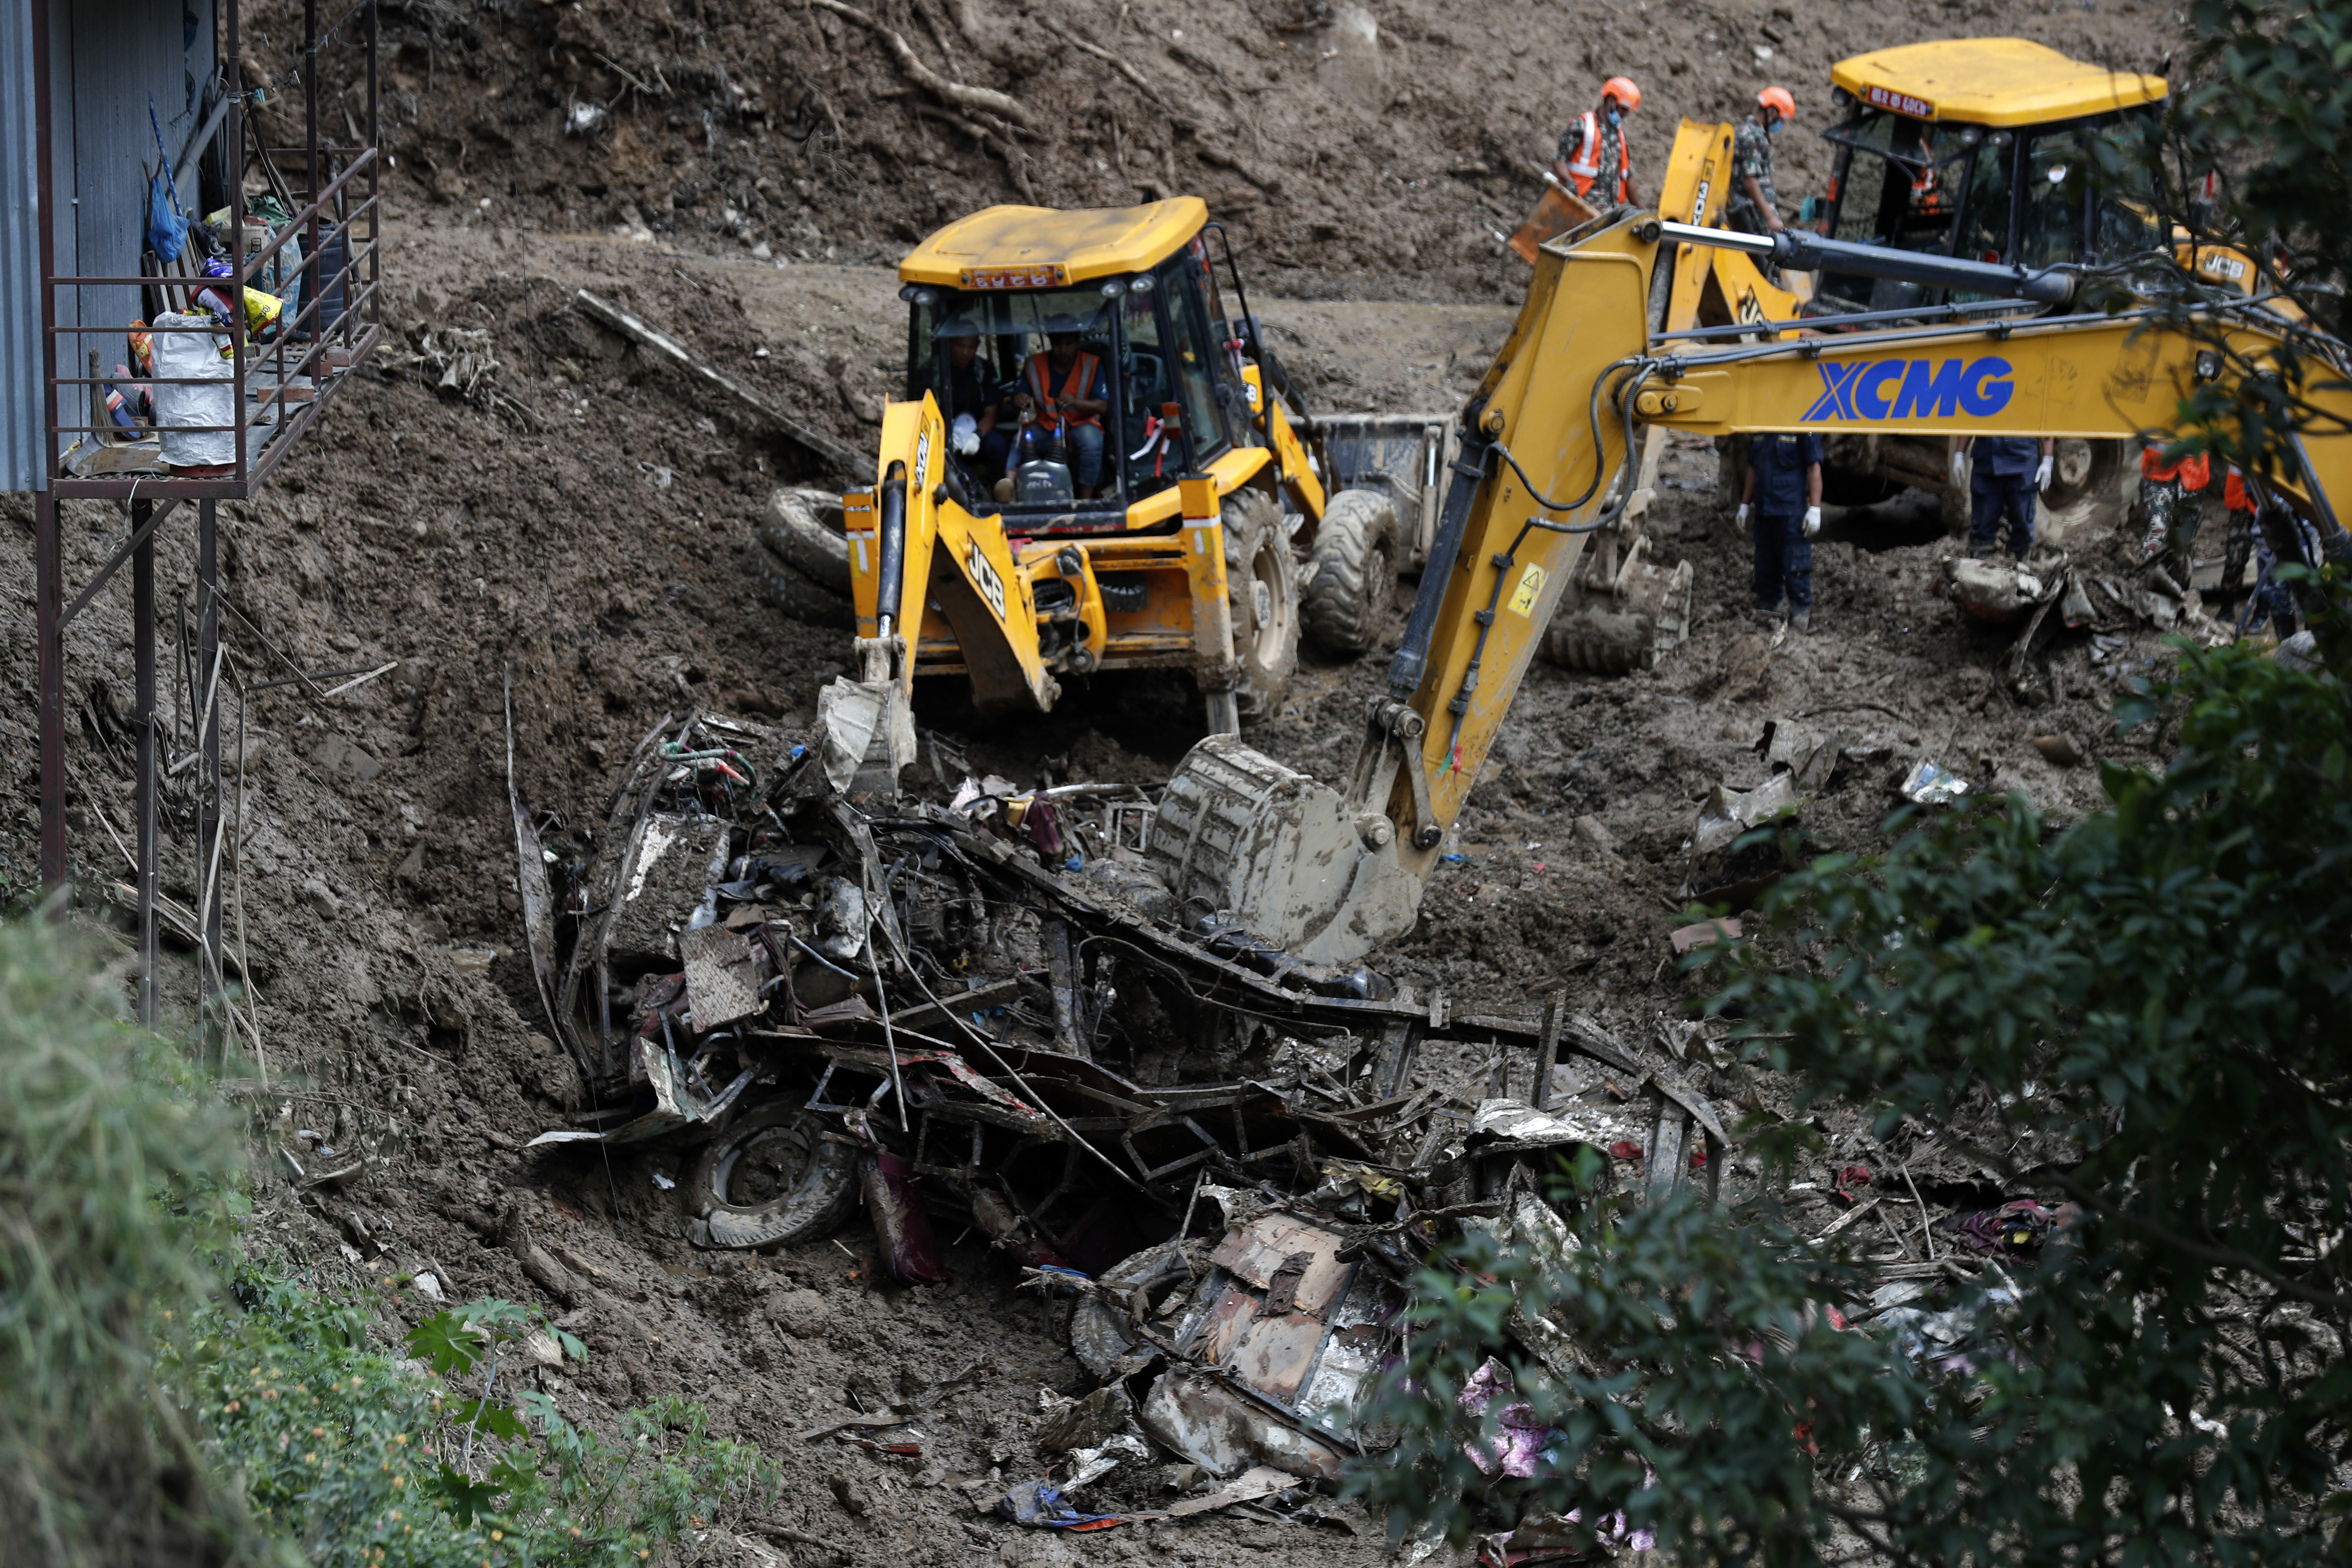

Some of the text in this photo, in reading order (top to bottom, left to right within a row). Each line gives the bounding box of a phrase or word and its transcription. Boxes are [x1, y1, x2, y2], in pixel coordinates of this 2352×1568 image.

[2205, 254, 2244, 279] JCB
[1799, 356, 2014, 421] XCMG
[968, 543, 1005, 619] JCB
